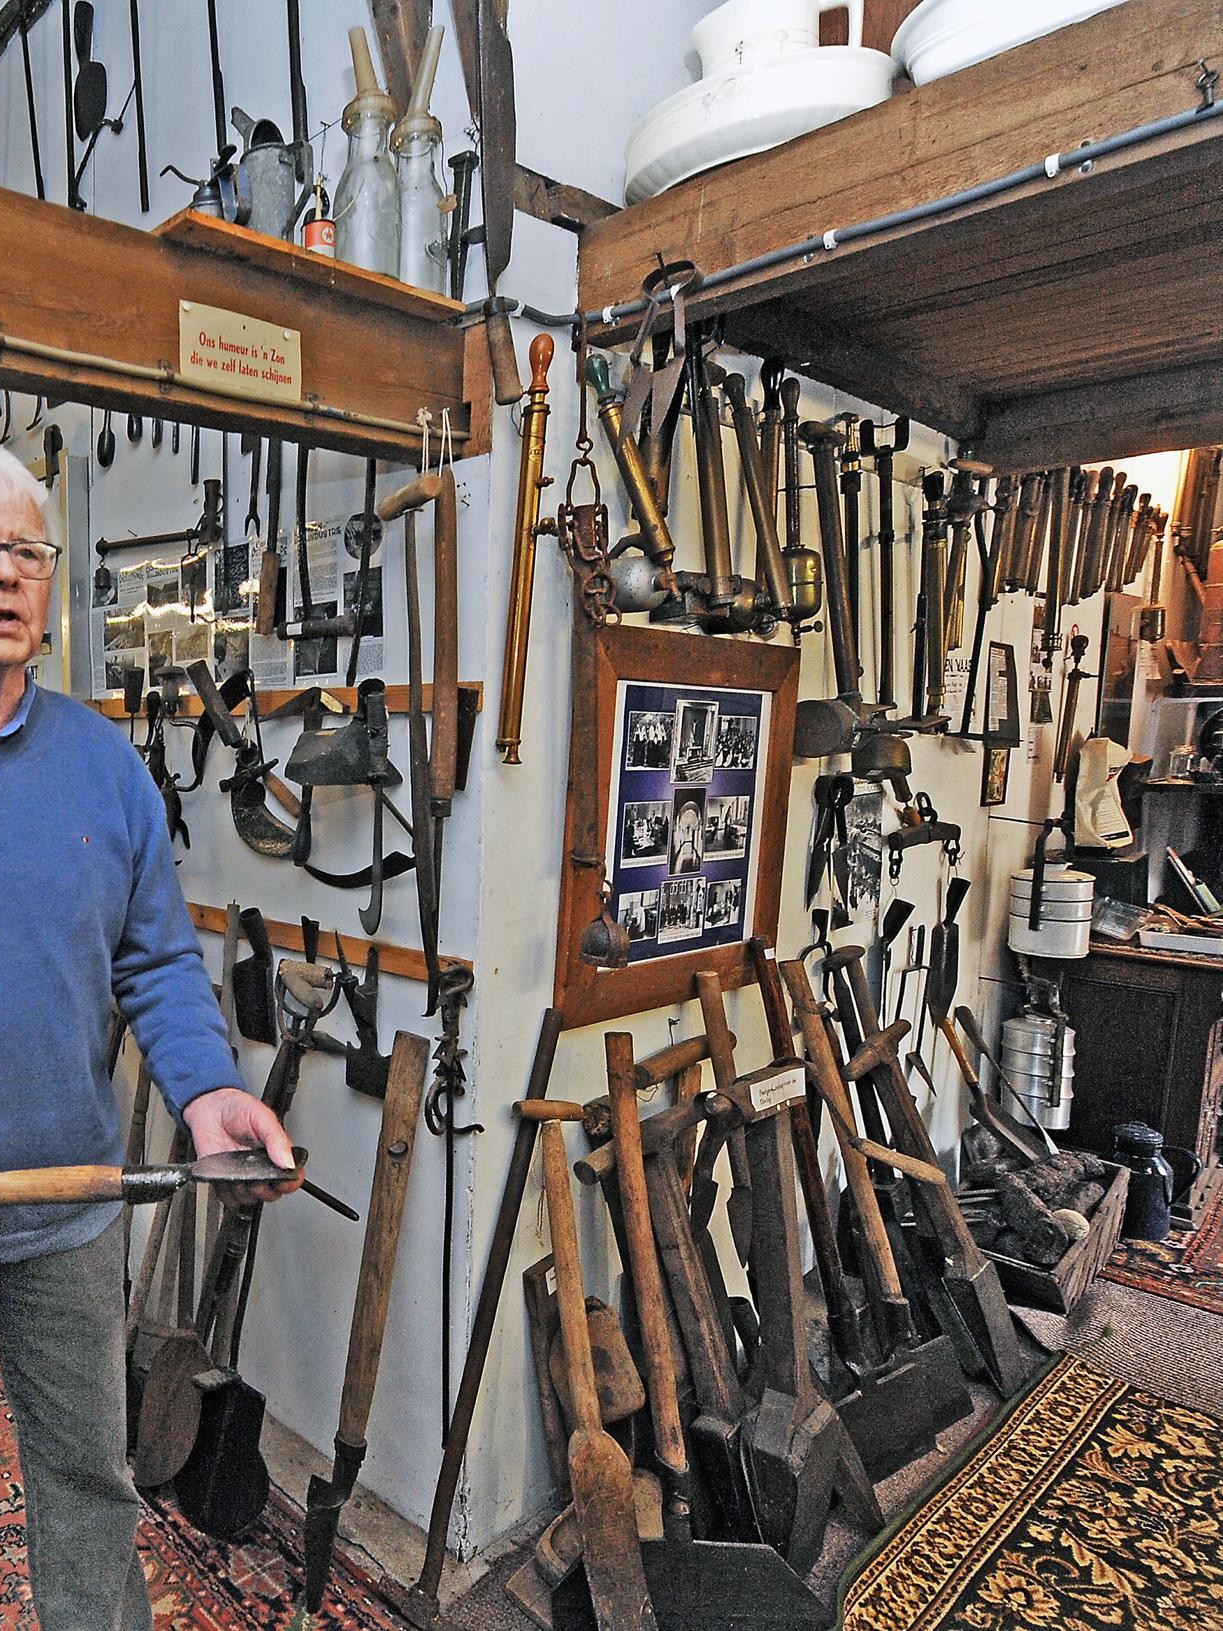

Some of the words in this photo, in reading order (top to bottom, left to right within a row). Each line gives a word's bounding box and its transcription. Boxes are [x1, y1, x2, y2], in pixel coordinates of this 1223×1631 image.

[199, 331, 216, 348] Ons
[219, 336, 249, 356] humeur
[251, 345, 258, 358] is
[260, 345, 268, 360] 'n
[270, 348, 285, 365] Zon
[190, 350, 203, 366] die
[206, 358, 218, 369] we
[221, 358, 236, 374] zelf
[238, 360, 259, 377] laten
[261, 367, 292, 385] schijnen
